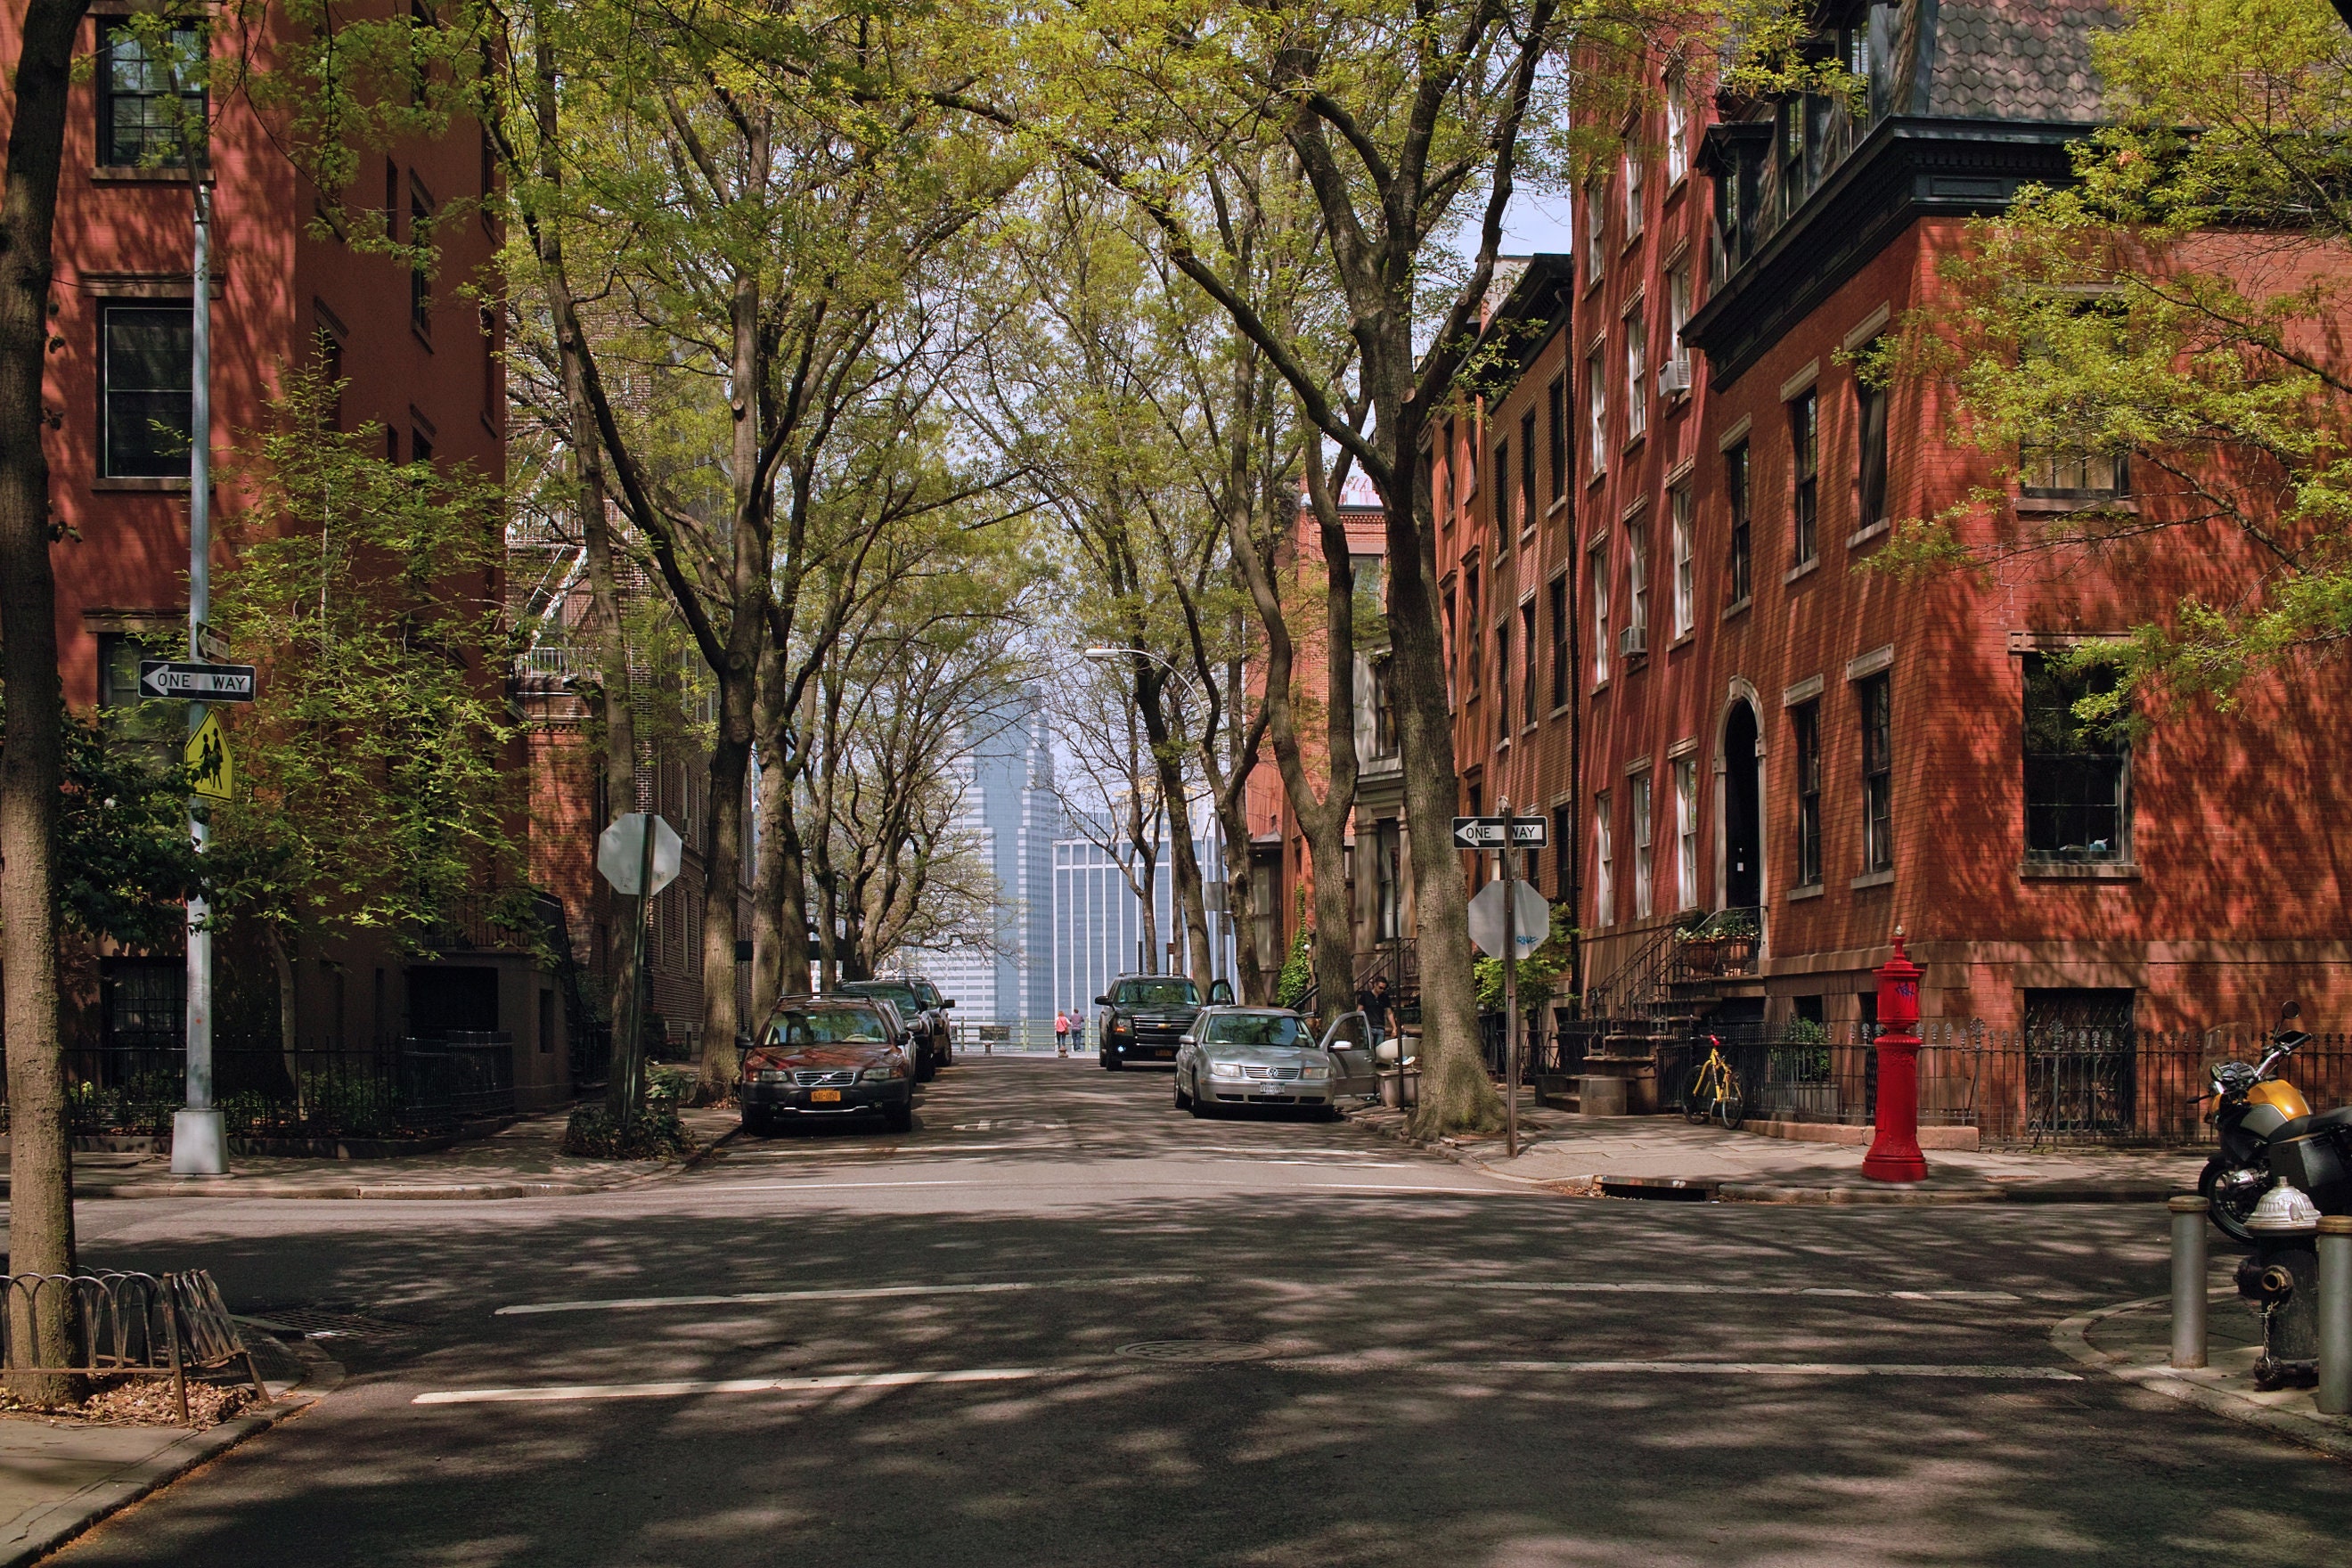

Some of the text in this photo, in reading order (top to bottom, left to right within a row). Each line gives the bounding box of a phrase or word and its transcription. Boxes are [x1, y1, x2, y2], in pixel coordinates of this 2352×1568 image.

[158, 673, 246, 690] ONE WAY
[1466, 827, 1491, 838] ONE
